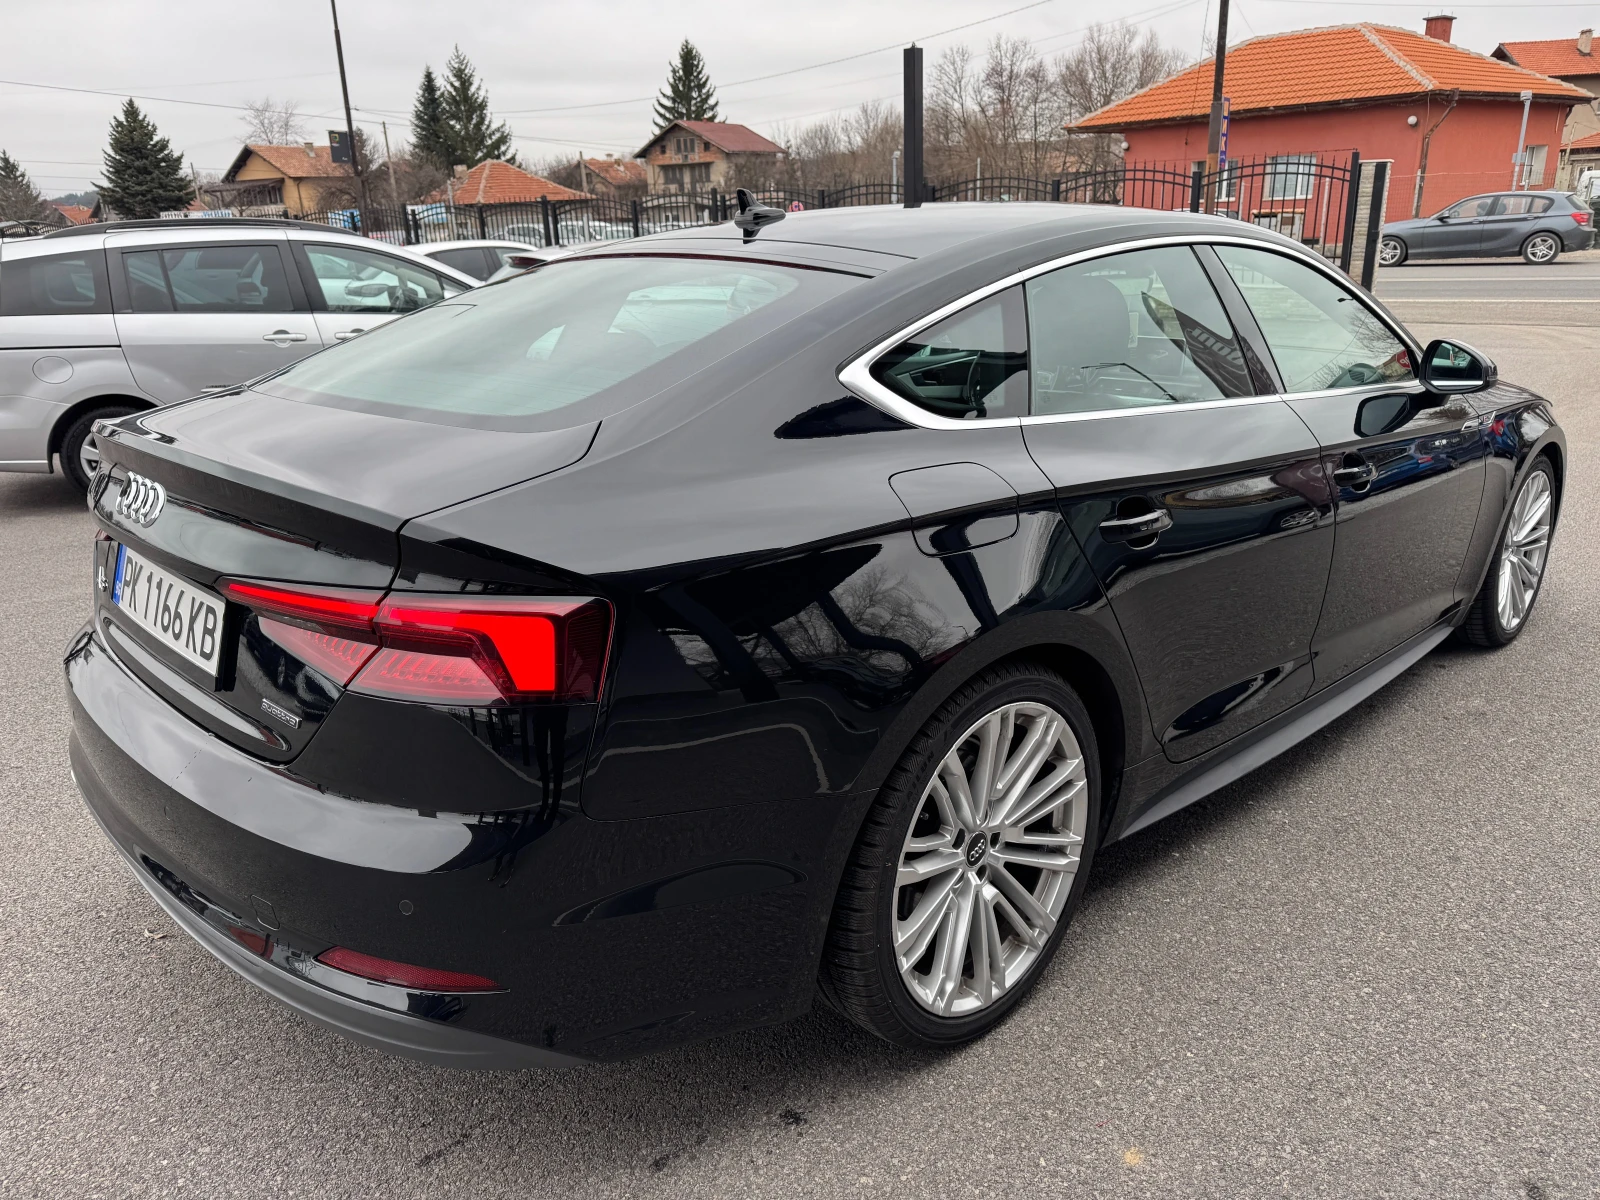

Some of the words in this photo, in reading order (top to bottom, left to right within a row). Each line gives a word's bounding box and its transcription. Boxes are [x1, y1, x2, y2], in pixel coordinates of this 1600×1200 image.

[121, 555, 143, 613] PK
[144, 571, 185, 641] 1166
[186, 596, 217, 661] KB
[261, 702, 296, 726] quattro
